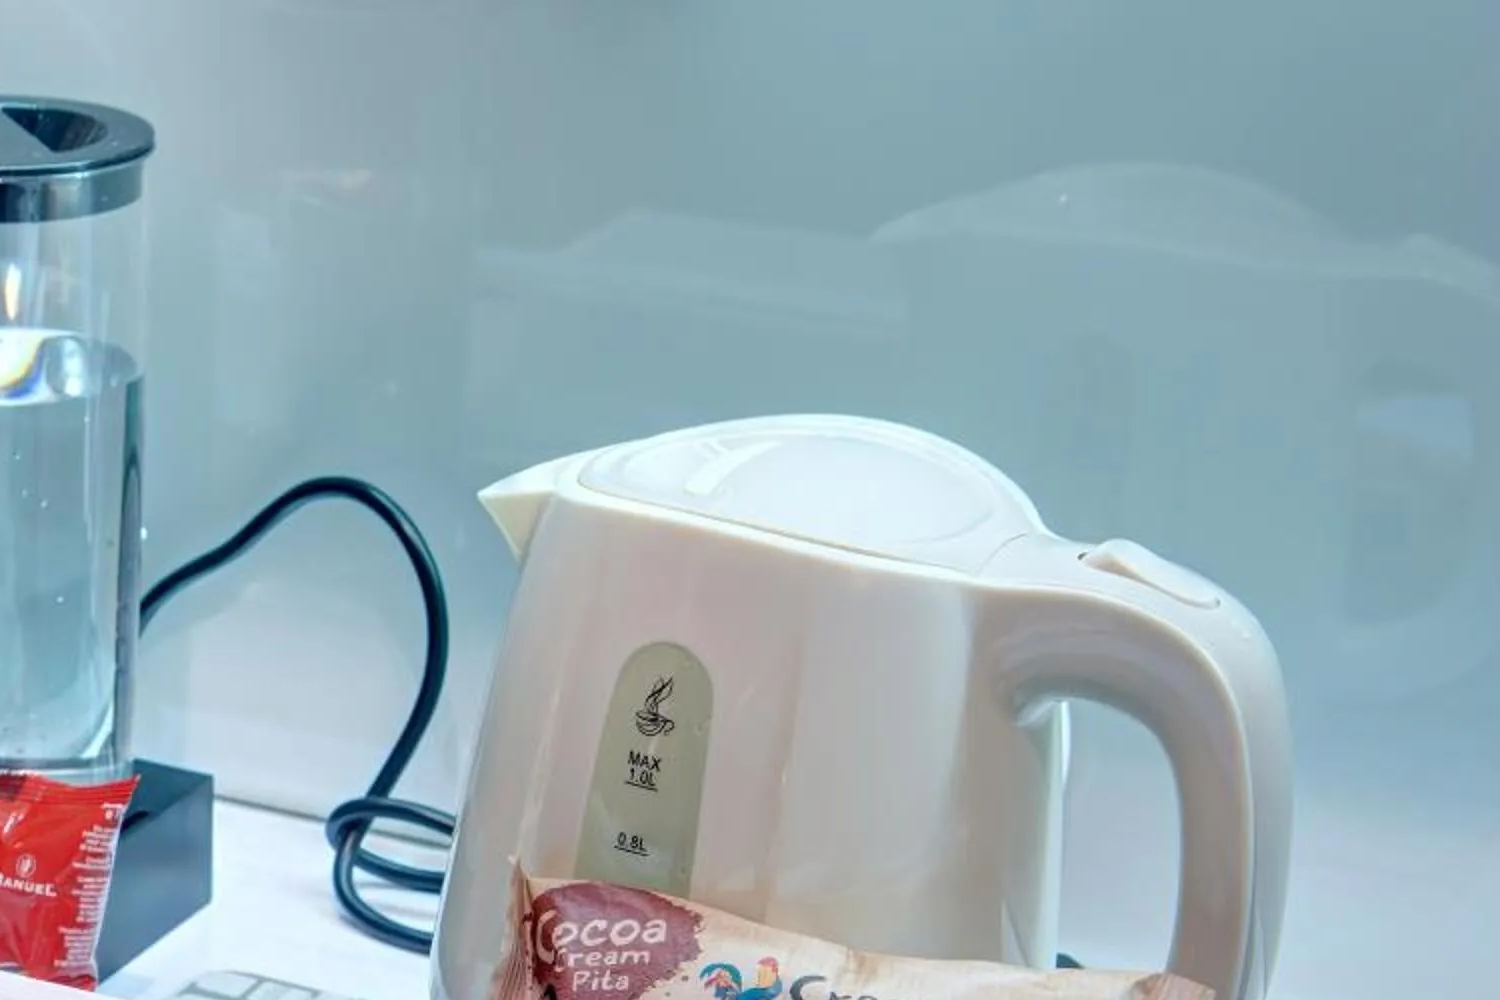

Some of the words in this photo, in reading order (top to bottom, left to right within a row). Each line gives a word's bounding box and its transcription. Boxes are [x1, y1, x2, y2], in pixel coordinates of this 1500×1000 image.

[627, 750, 662, 773] MAX
[535, 909, 668, 965] Cocoa
[553, 948, 651, 973] Cream
[572, 970, 630, 993] Pita
